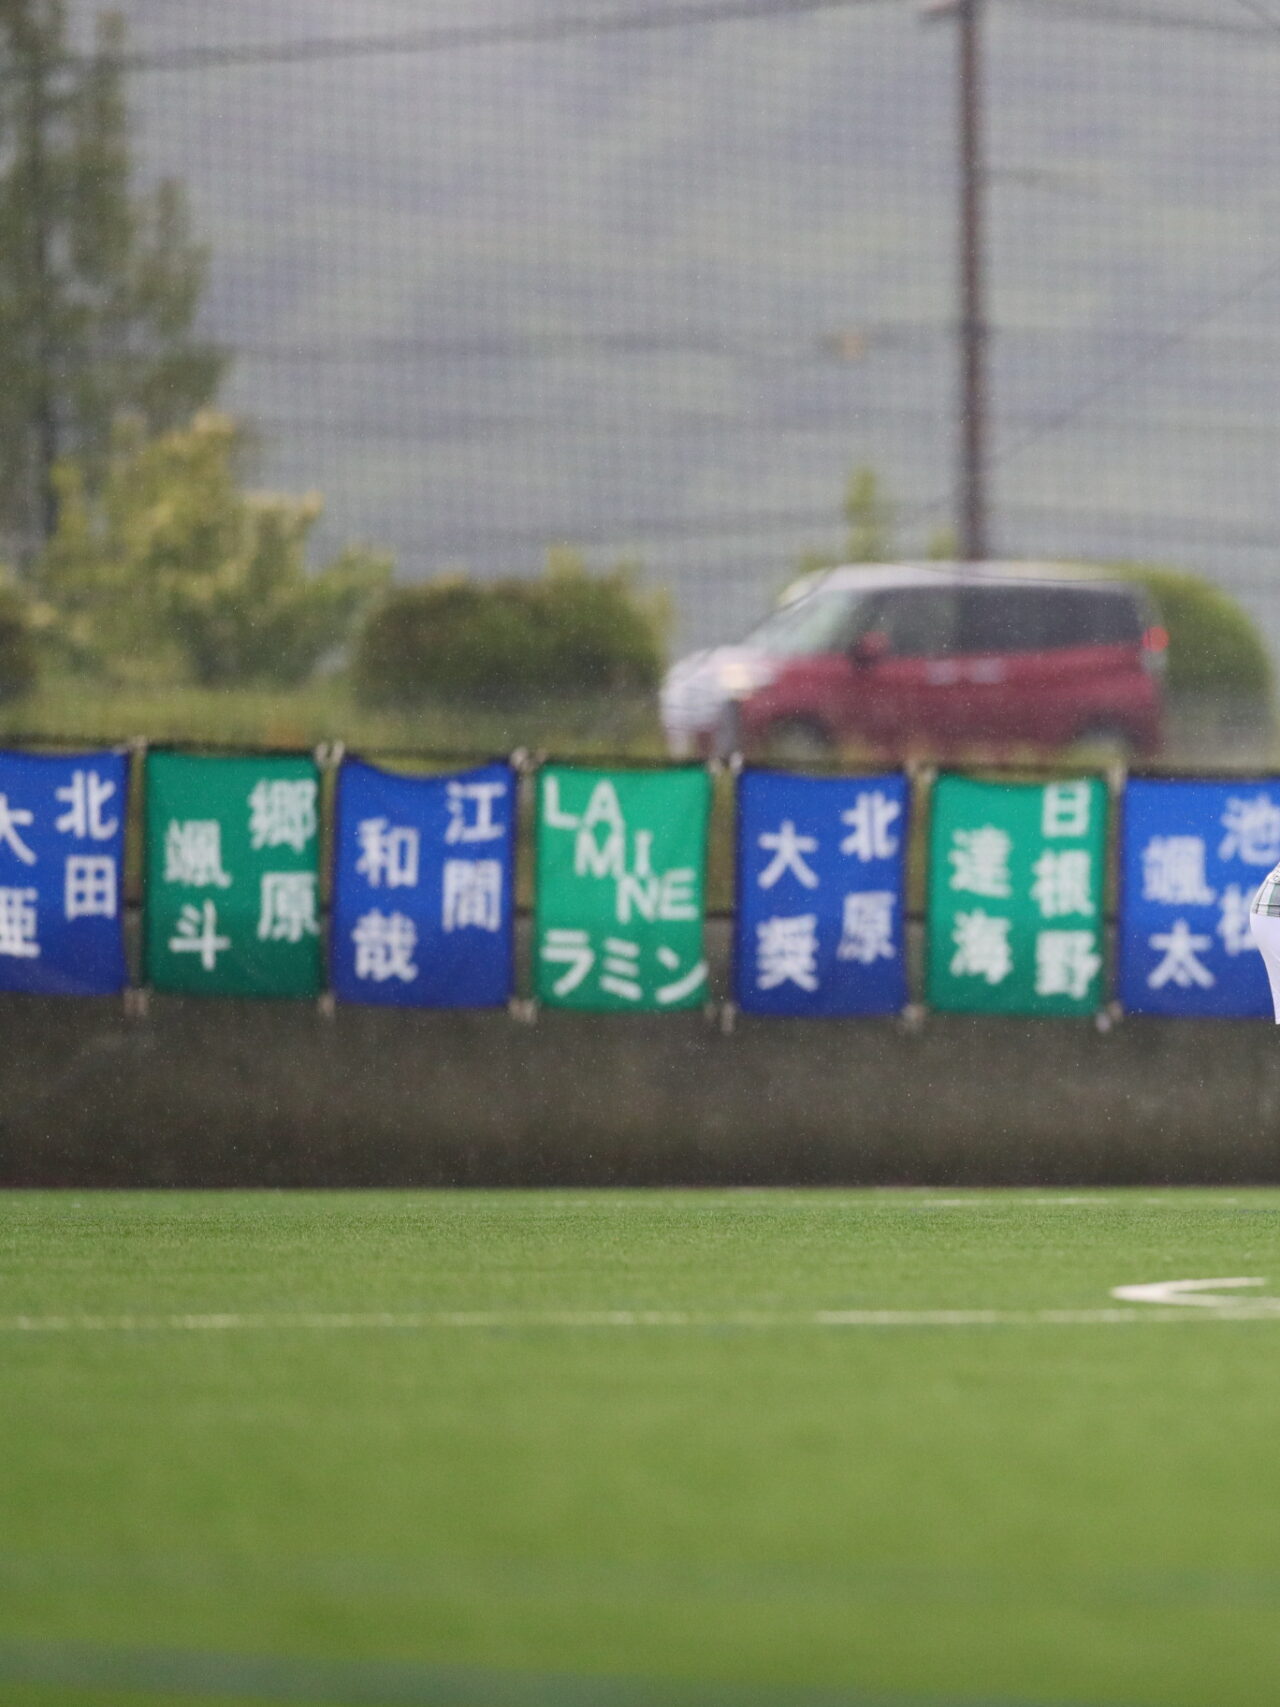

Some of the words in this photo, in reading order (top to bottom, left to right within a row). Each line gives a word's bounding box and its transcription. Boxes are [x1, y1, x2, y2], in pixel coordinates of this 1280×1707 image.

[55, 770, 119, 921] 北田
[351, 817, 419, 982] 和哉
[441, 781, 507, 932] 江間
[837, 790, 900, 964] 北原
[541, 928, 708, 1004] ラミン
